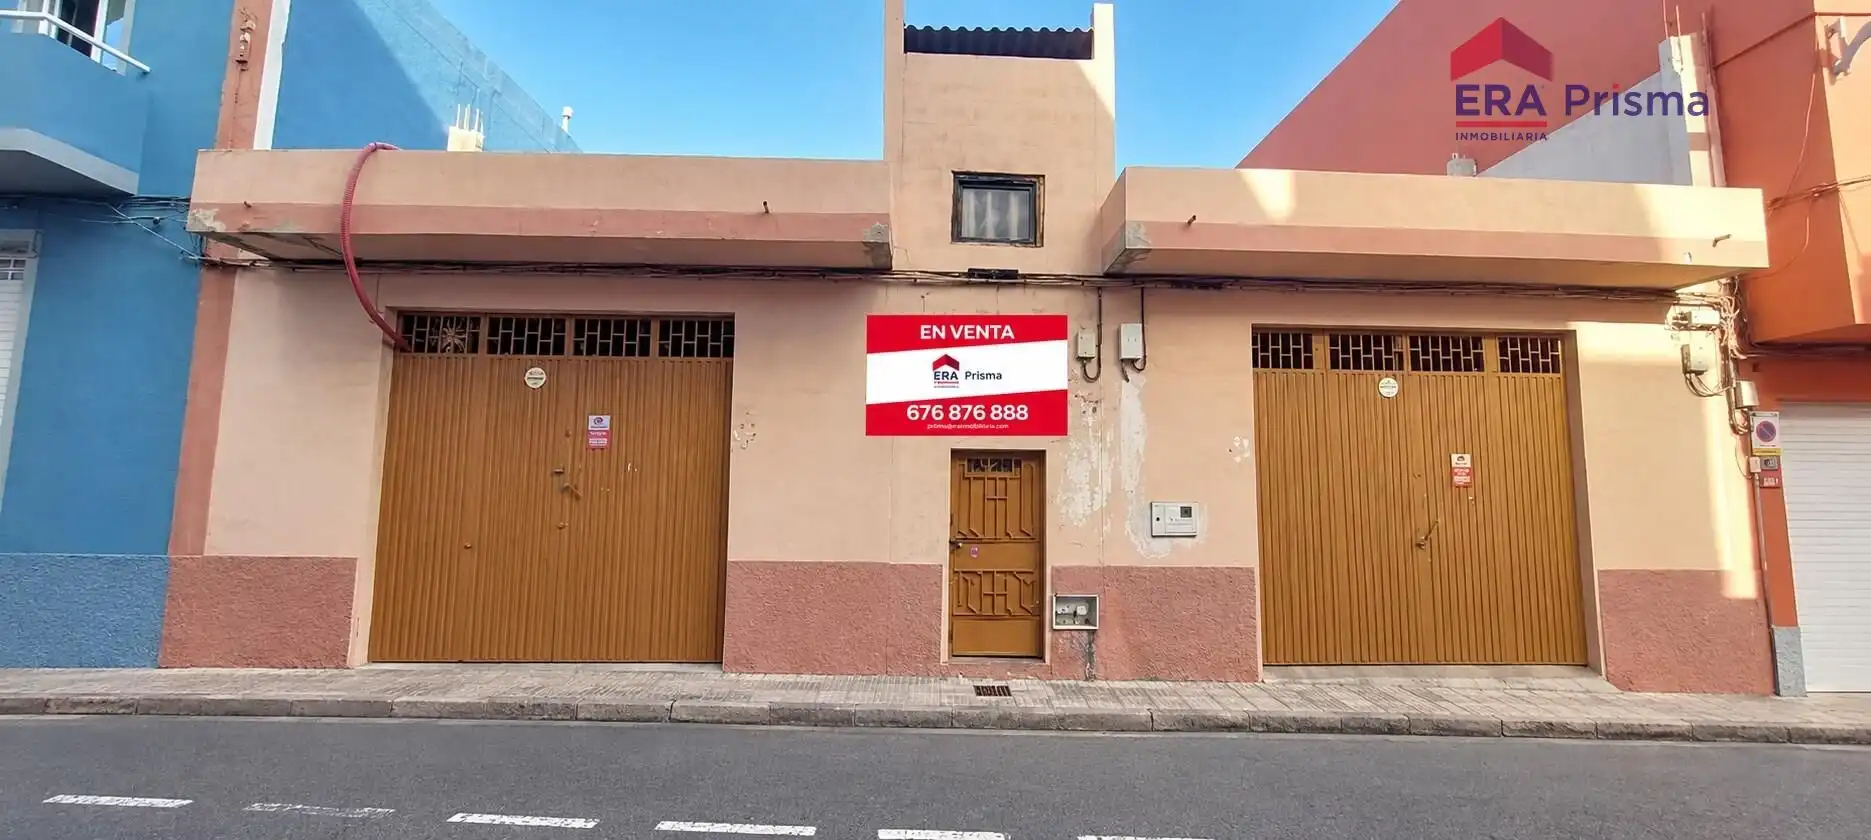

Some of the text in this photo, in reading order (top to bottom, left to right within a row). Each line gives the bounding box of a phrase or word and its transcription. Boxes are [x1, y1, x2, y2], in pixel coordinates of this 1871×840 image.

[920, 324, 1015, 340] EN VENTA
[933, 370, 1003, 381] ERA Prisma
[906, 404, 1029, 421] 676 876 888
